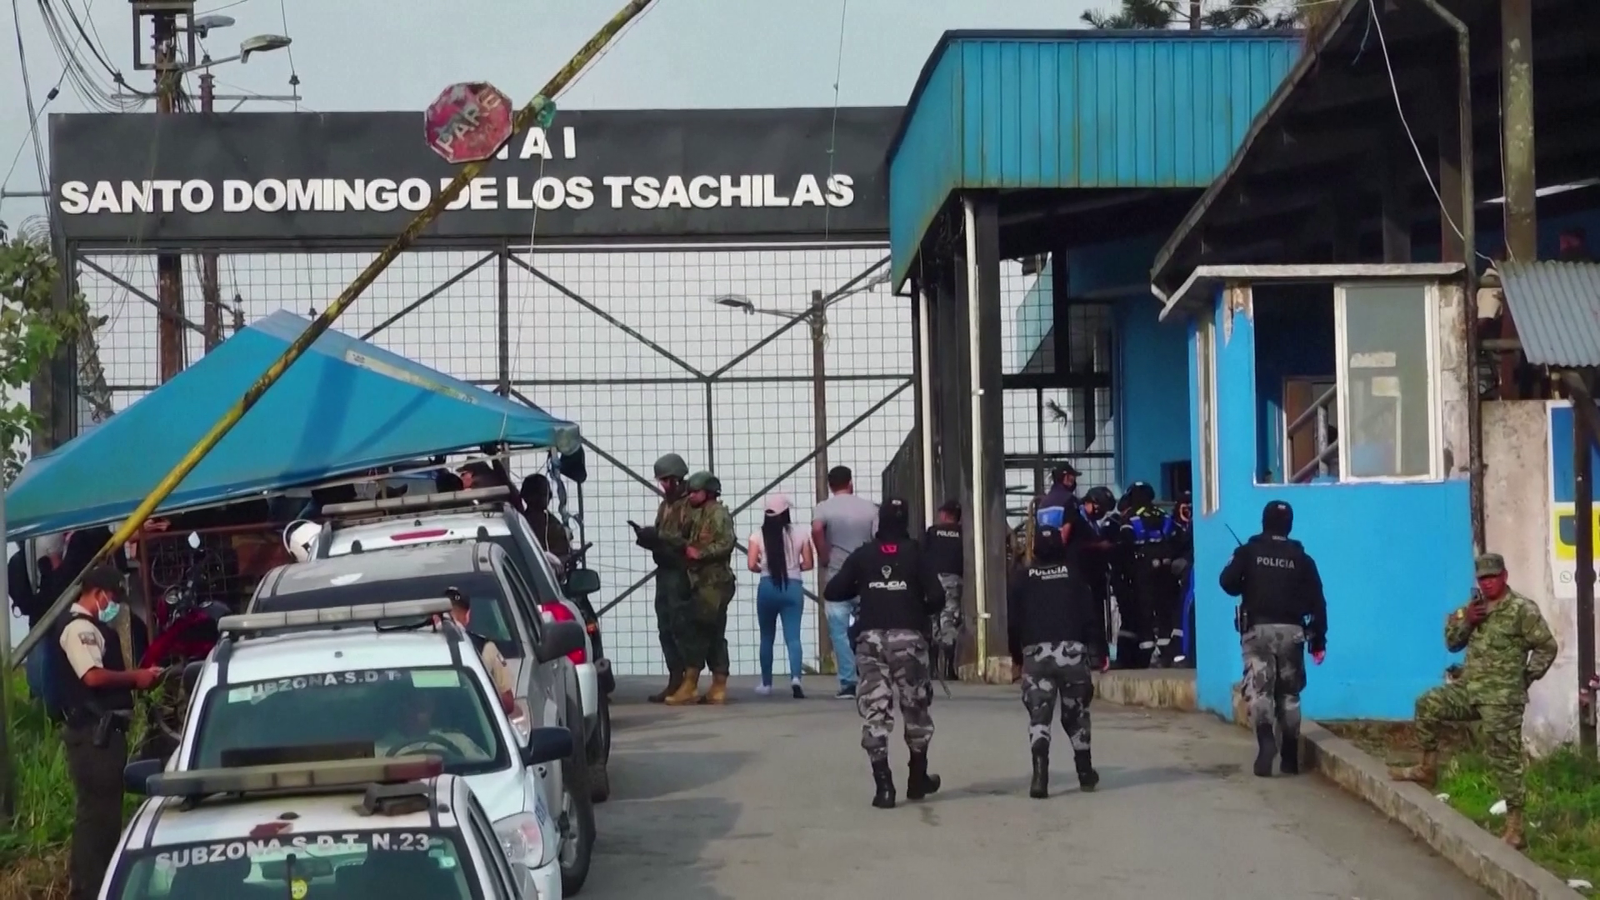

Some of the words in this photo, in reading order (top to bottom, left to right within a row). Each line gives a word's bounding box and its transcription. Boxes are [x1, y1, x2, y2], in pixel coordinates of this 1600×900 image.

[434, 87, 502, 154] PARE
[60, 180, 214, 214] SANTO
[223, 178, 432, 213] DOMINGO
[507, 176, 594, 210] LOS
[603, 174, 855, 210] TSACHILAS
[1257, 556, 1295, 569] POLICIA
[155, 838, 283, 869] SUBZONA
